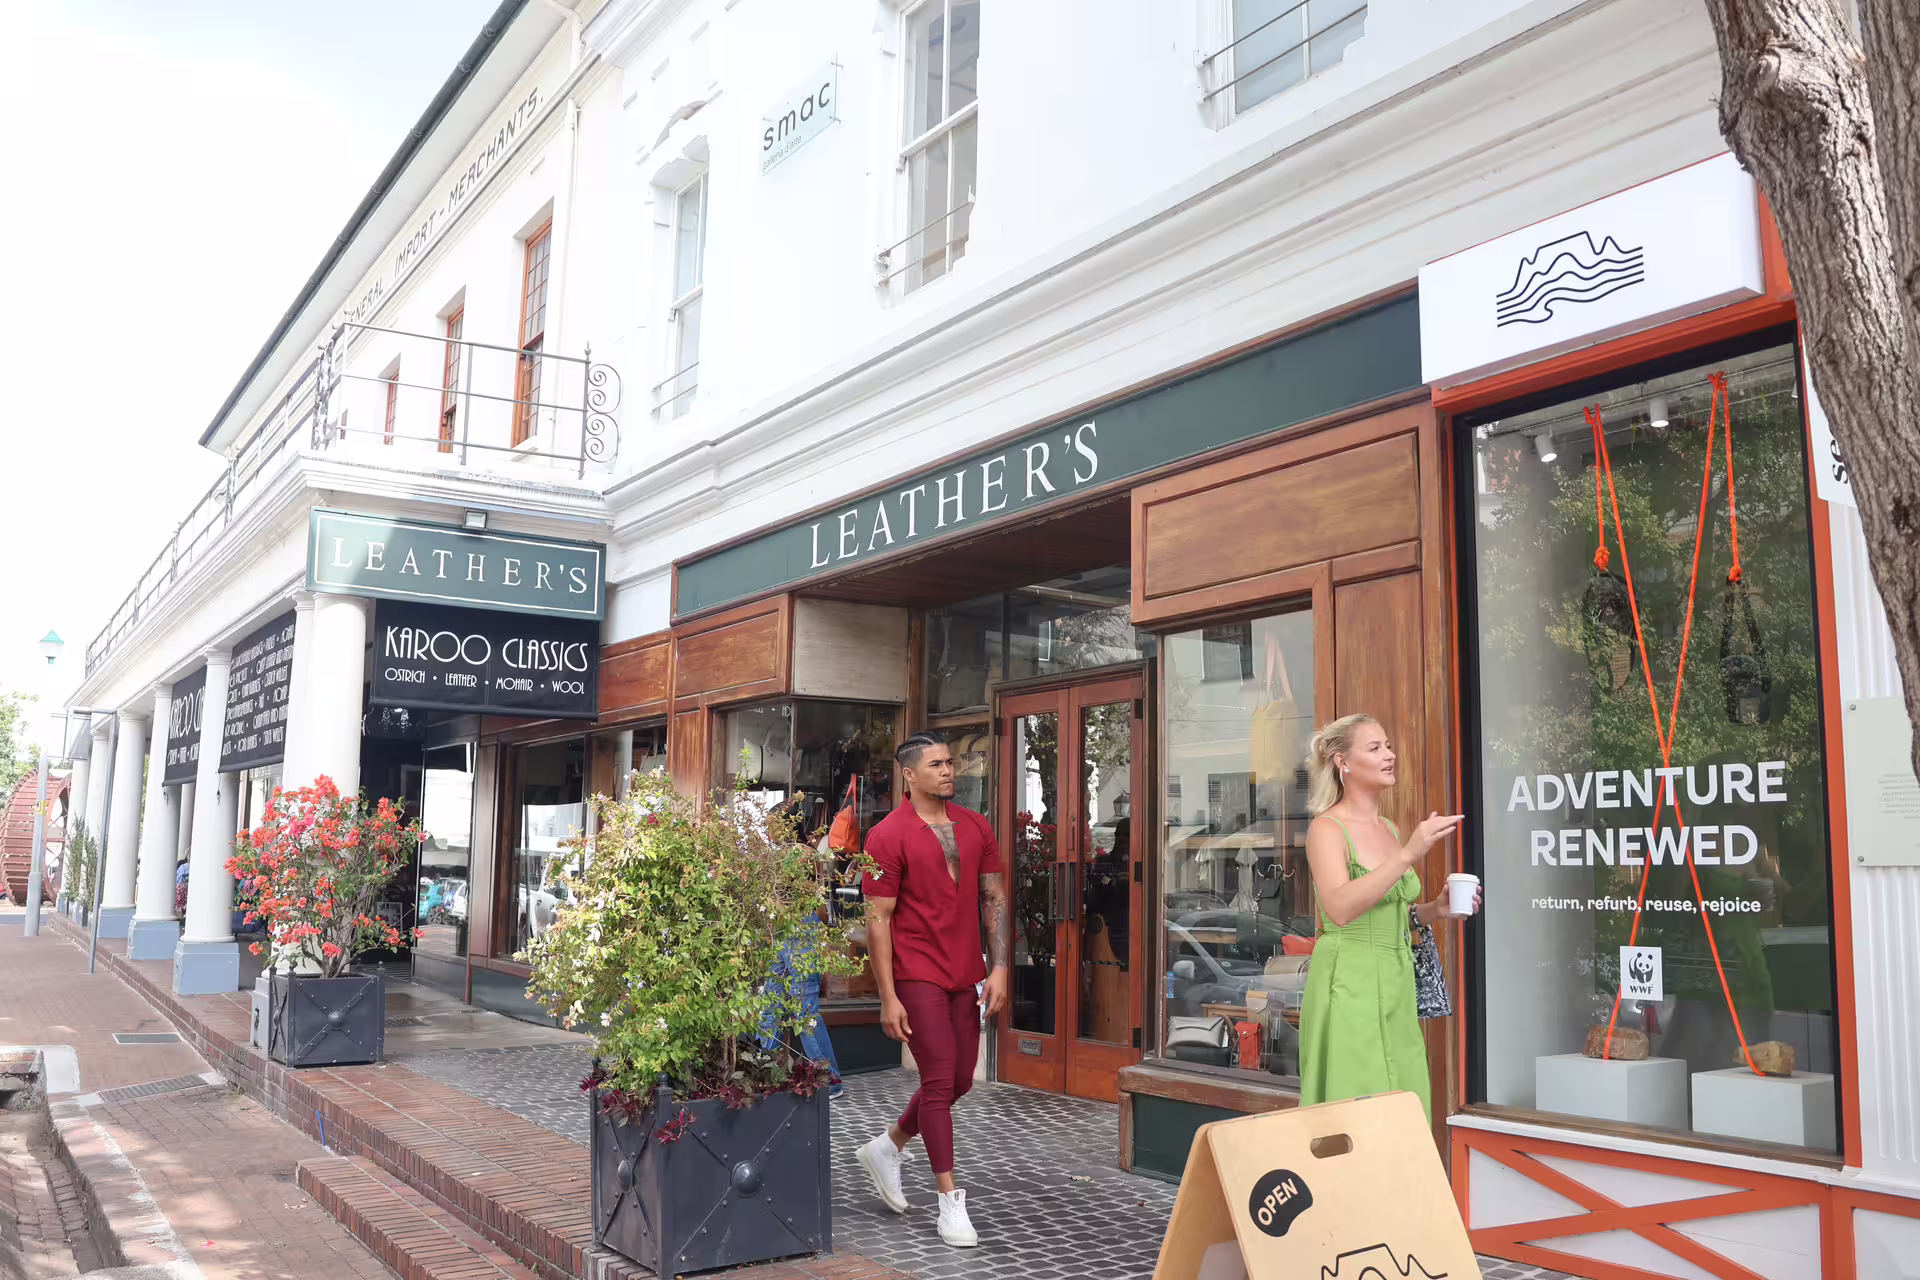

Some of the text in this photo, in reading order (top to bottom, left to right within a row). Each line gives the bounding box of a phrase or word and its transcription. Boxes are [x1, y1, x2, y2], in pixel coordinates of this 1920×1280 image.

[763, 82, 830, 151] smac
[394, 211, 436, 277] IMPORT
[809, 420, 1098, 570] LEATHER'S
[330, 537, 588, 594] LEATHER'S
[385, 625, 588, 672] KAROO CLASSICS
[385, 667, 585, 695] OSTRICH LEATHER MOHAIR WOOL
[1507, 761, 1788, 812] ADVENTURE
[1530, 825, 1758, 866] RENEWED
[1531, 896, 1762, 916] return, refurb, reuse, rejoice
[1629, 985, 1654, 995] WWF
[1257, 1177, 1299, 1226] OPEN
